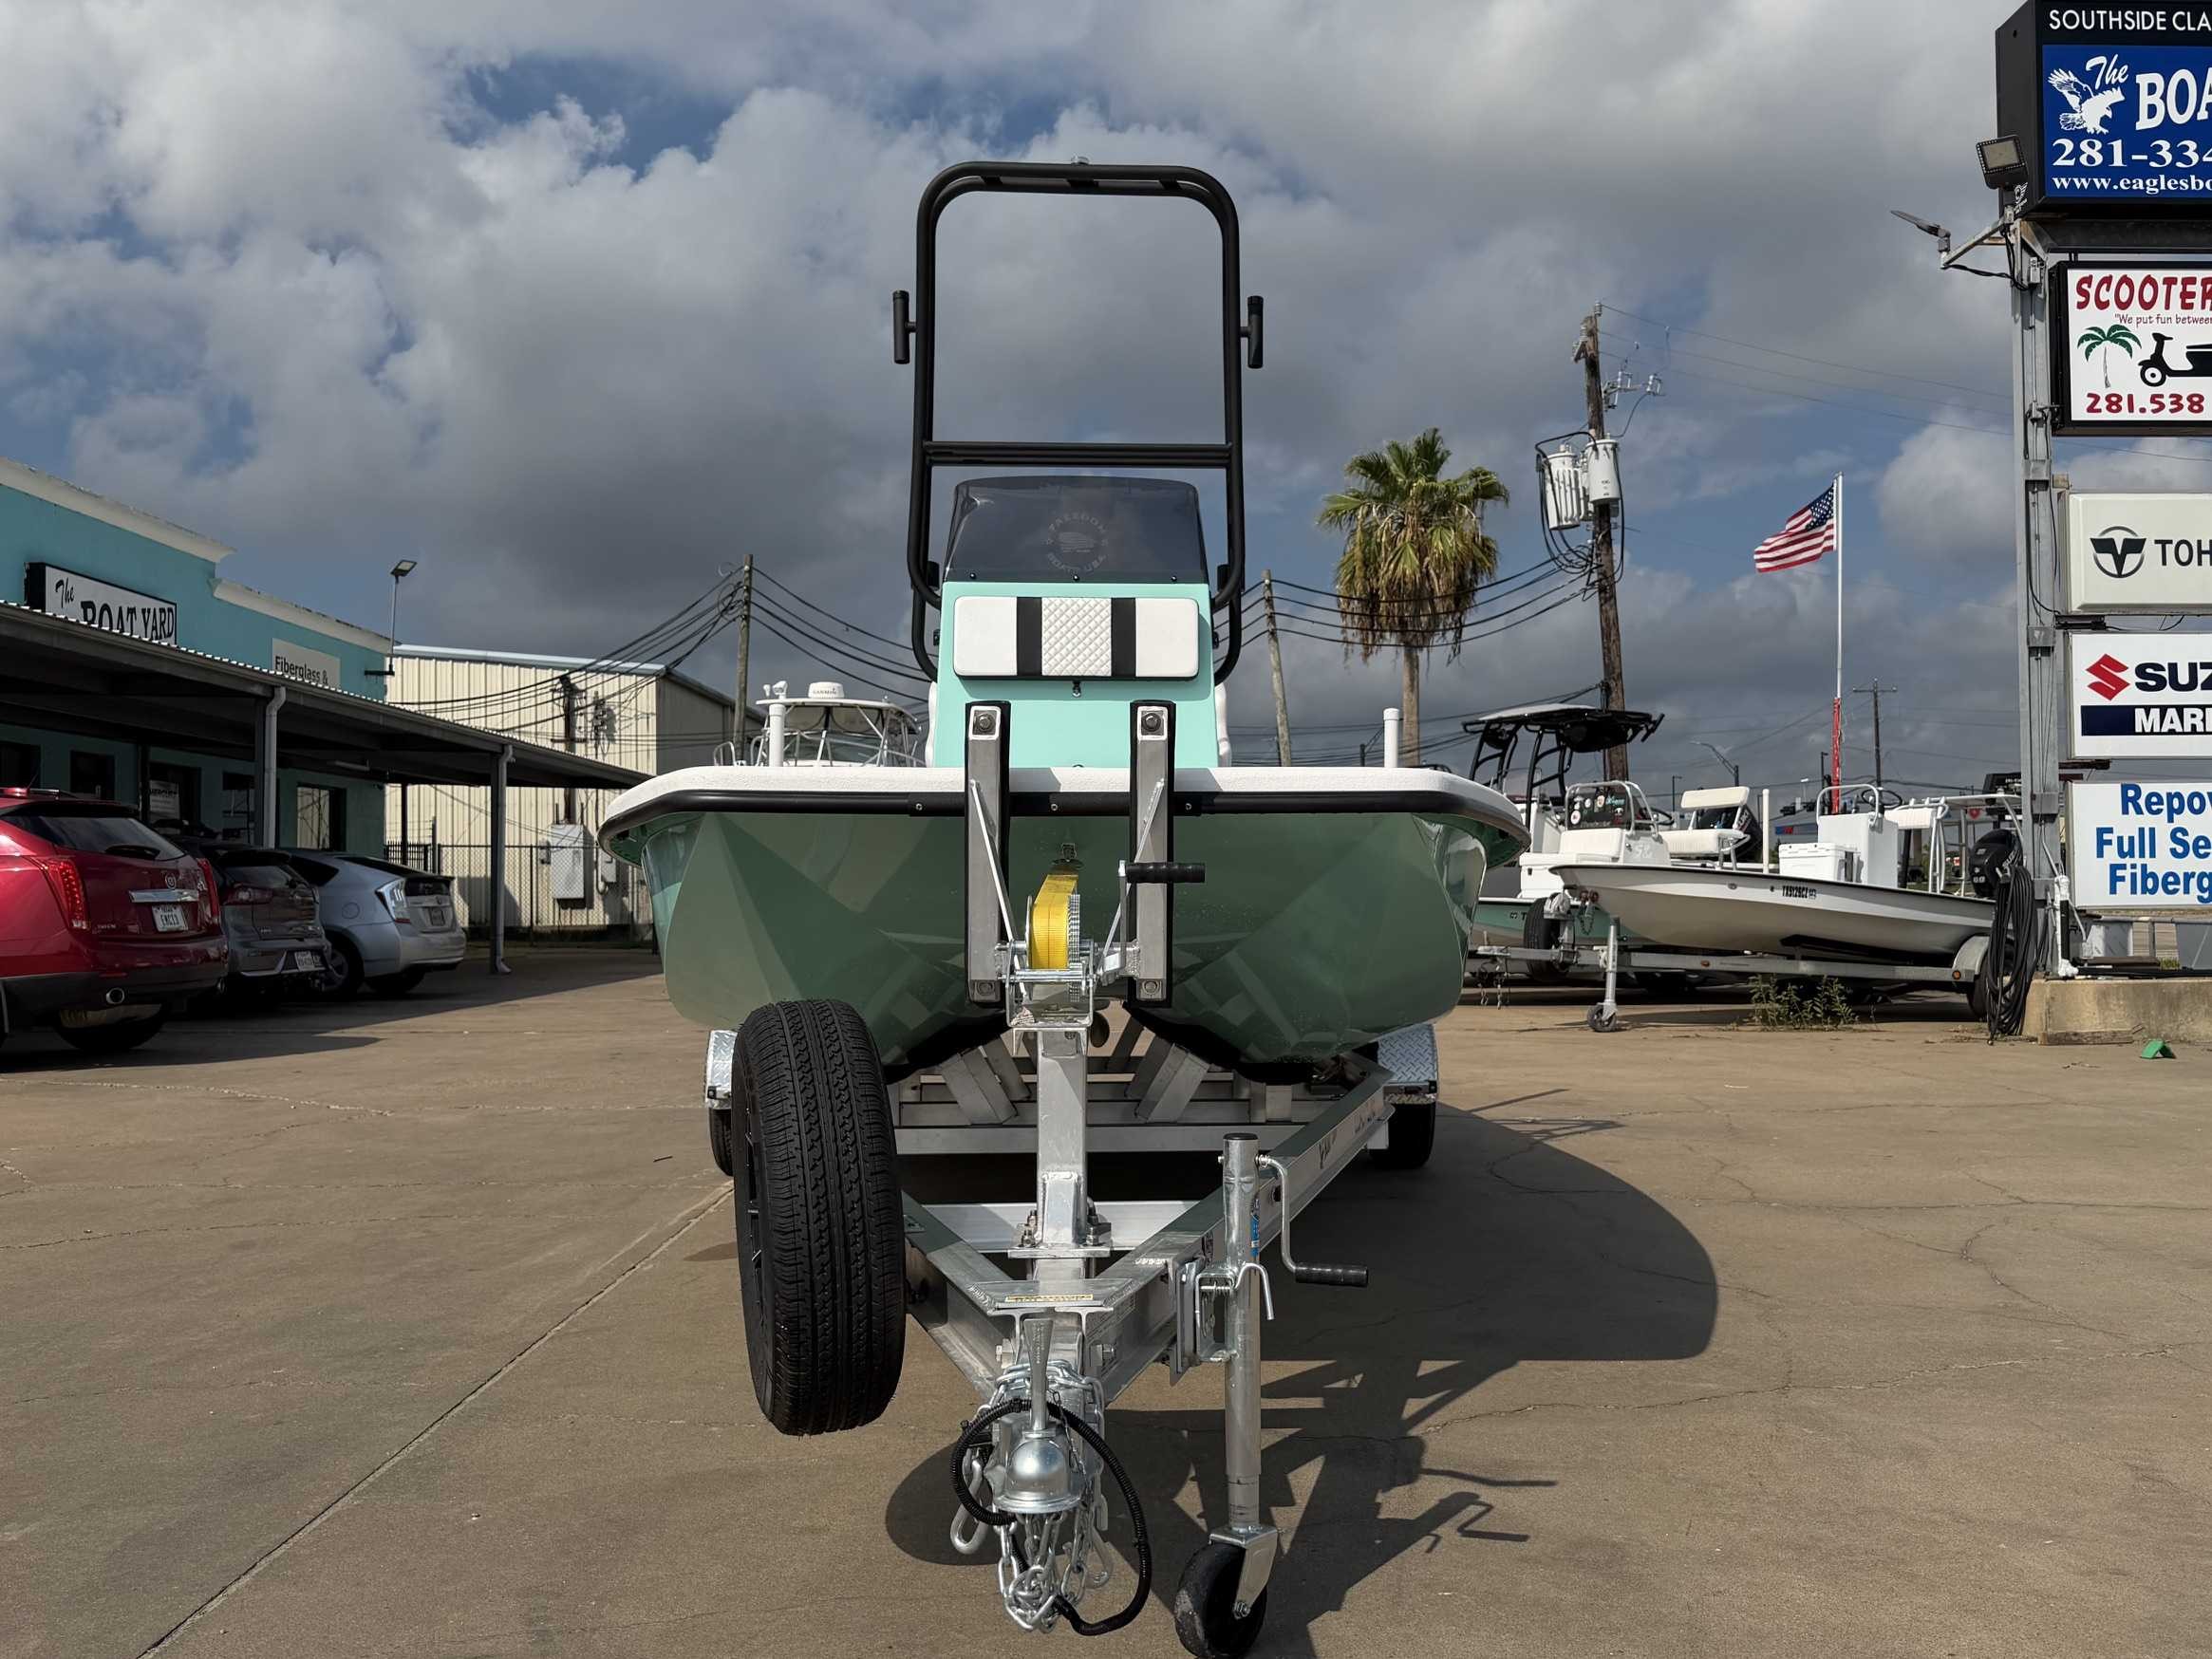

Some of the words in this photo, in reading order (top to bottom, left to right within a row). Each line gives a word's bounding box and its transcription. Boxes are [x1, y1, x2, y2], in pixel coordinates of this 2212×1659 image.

[2049, 9, 2166, 30] SOUTHSIDE
[2172, 10, 2212, 31] CLA
[2086, 54, 2129, 89] The
[2075, 274, 2212, 311] SCOOTER
[2136, 315, 2155, 328] put
[2156, 313, 2172, 324] fun
[2086, 393, 2204, 414] 281.538
[2154, 539, 2212, 567] TOH
[55, 577, 74, 608] The
[141, 606, 175, 641] YARD
[2120, 783, 2212, 823] Repo
[2096, 827, 2156, 859] Full
[2169, 826, 2212, 859] Se
[2109, 863, 2212, 904] Fiberg
